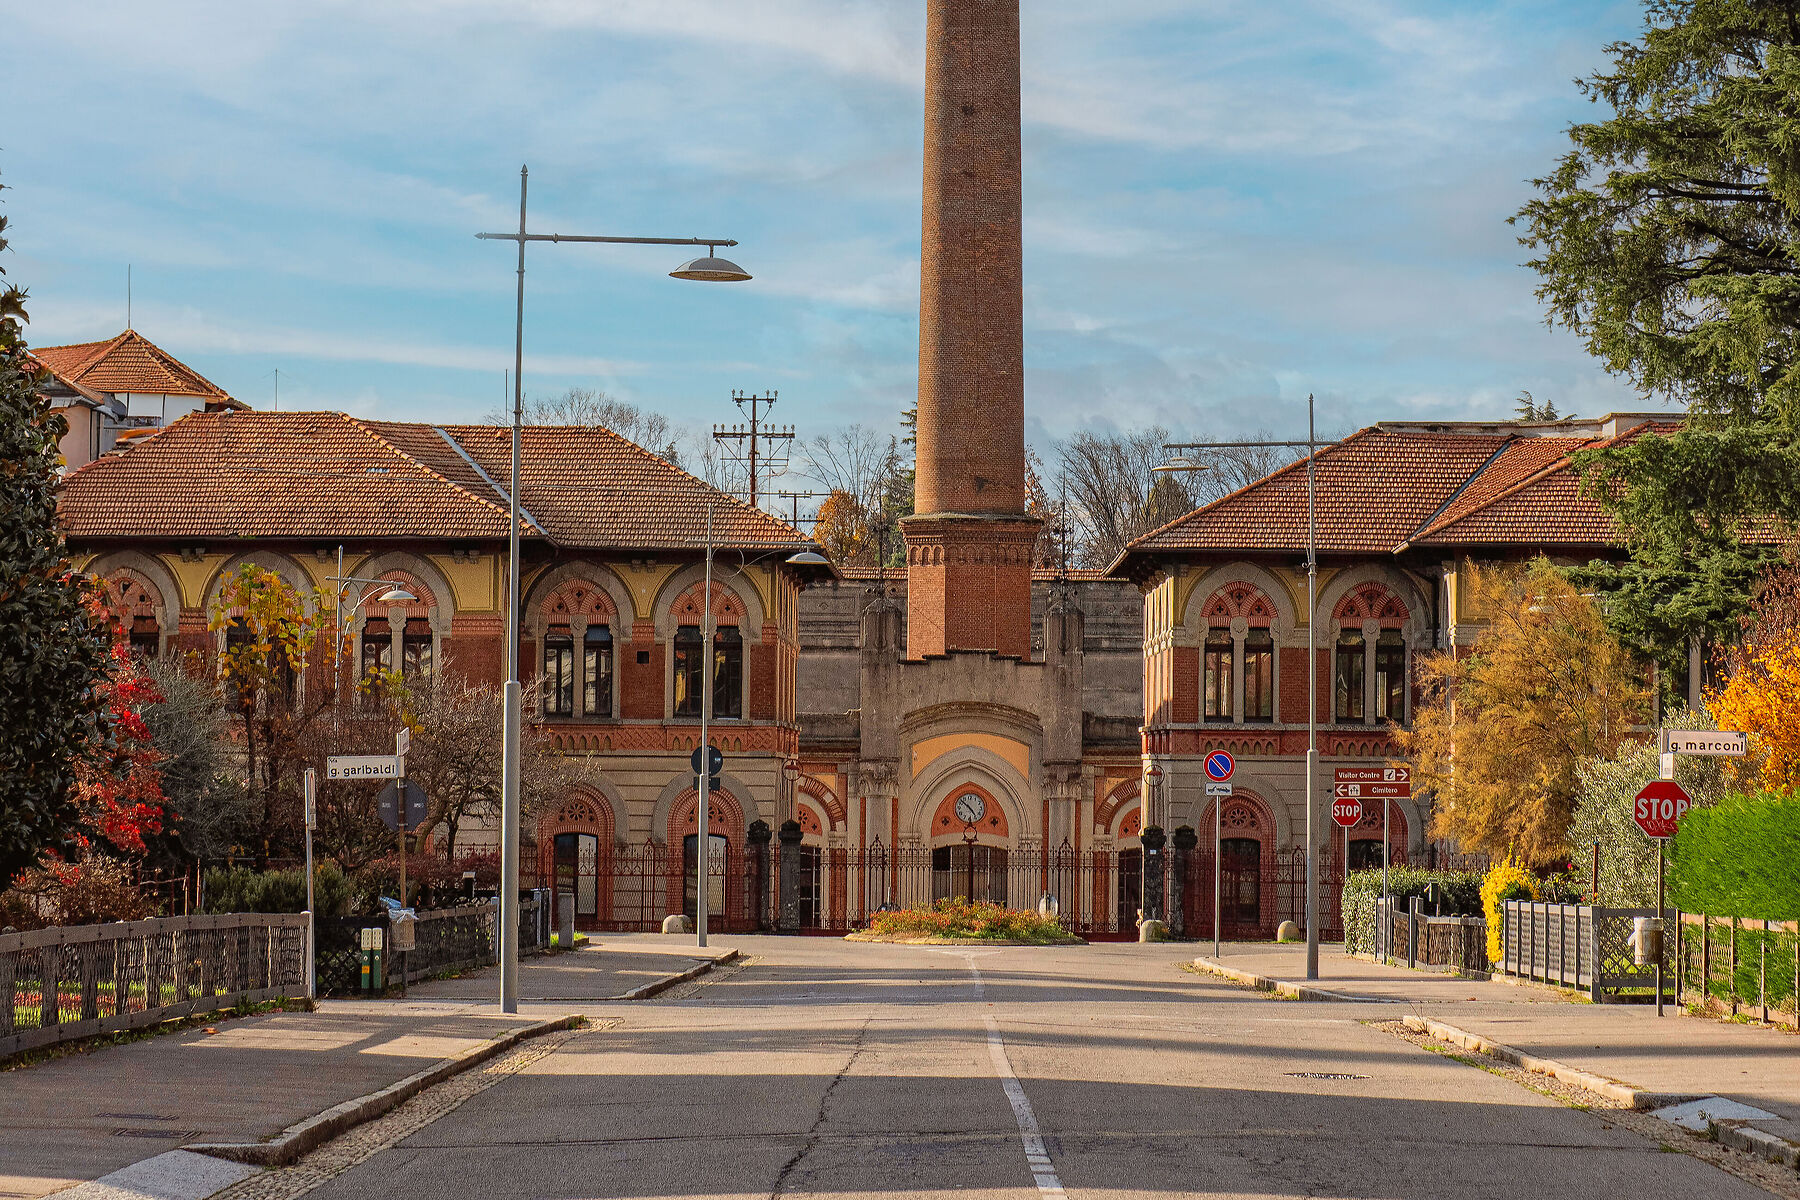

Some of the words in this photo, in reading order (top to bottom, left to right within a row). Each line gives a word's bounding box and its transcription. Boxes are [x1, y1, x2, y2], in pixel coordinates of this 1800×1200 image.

[1671, 742, 1681, 752] g.
[1686, 742, 1744, 752] marconi
[330, 768, 340, 777] g.
[343, 764, 395, 777] garibaldi
[1334, 805, 1360, 817] STOP
[1637, 798, 1687, 820] STOP
